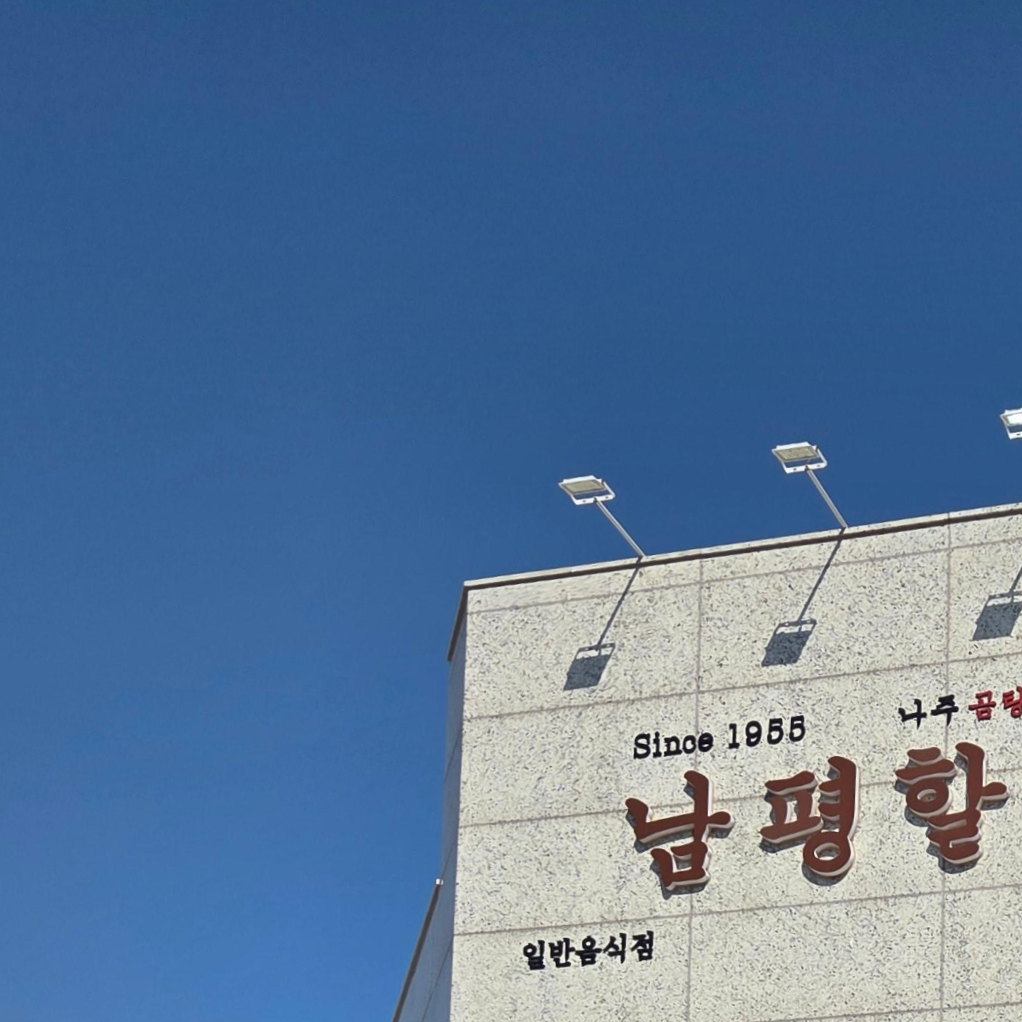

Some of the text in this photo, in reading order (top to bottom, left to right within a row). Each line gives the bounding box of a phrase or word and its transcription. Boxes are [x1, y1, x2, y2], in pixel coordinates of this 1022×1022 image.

[898, 704, 957, 730] 나주
[634, 716, 806, 760] Since 1955
[523, 930, 655, 971] 일반음식점
